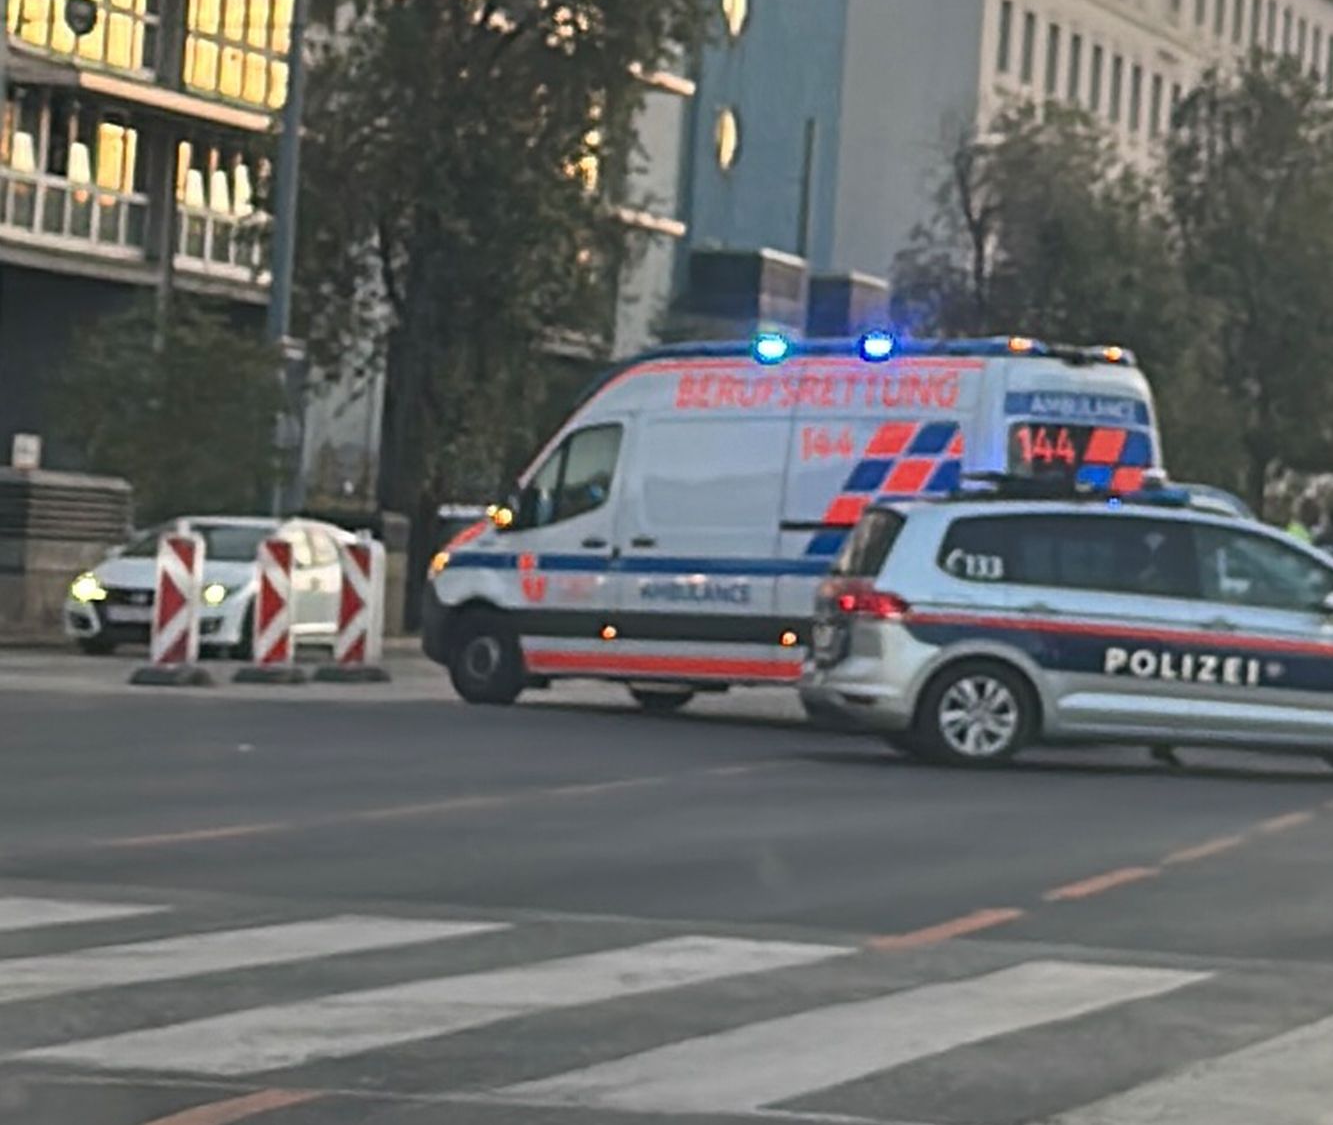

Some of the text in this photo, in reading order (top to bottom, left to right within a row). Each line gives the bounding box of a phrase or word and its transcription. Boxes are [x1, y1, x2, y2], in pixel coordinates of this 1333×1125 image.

[675, 371, 961, 410] BERUFSRETTUNG
[802, 426, 854, 461] 144
[1017, 424, 1076, 465] 144
[965, 553, 1003, 579] 133
[1105, 647, 1262, 686] POLIZEI
